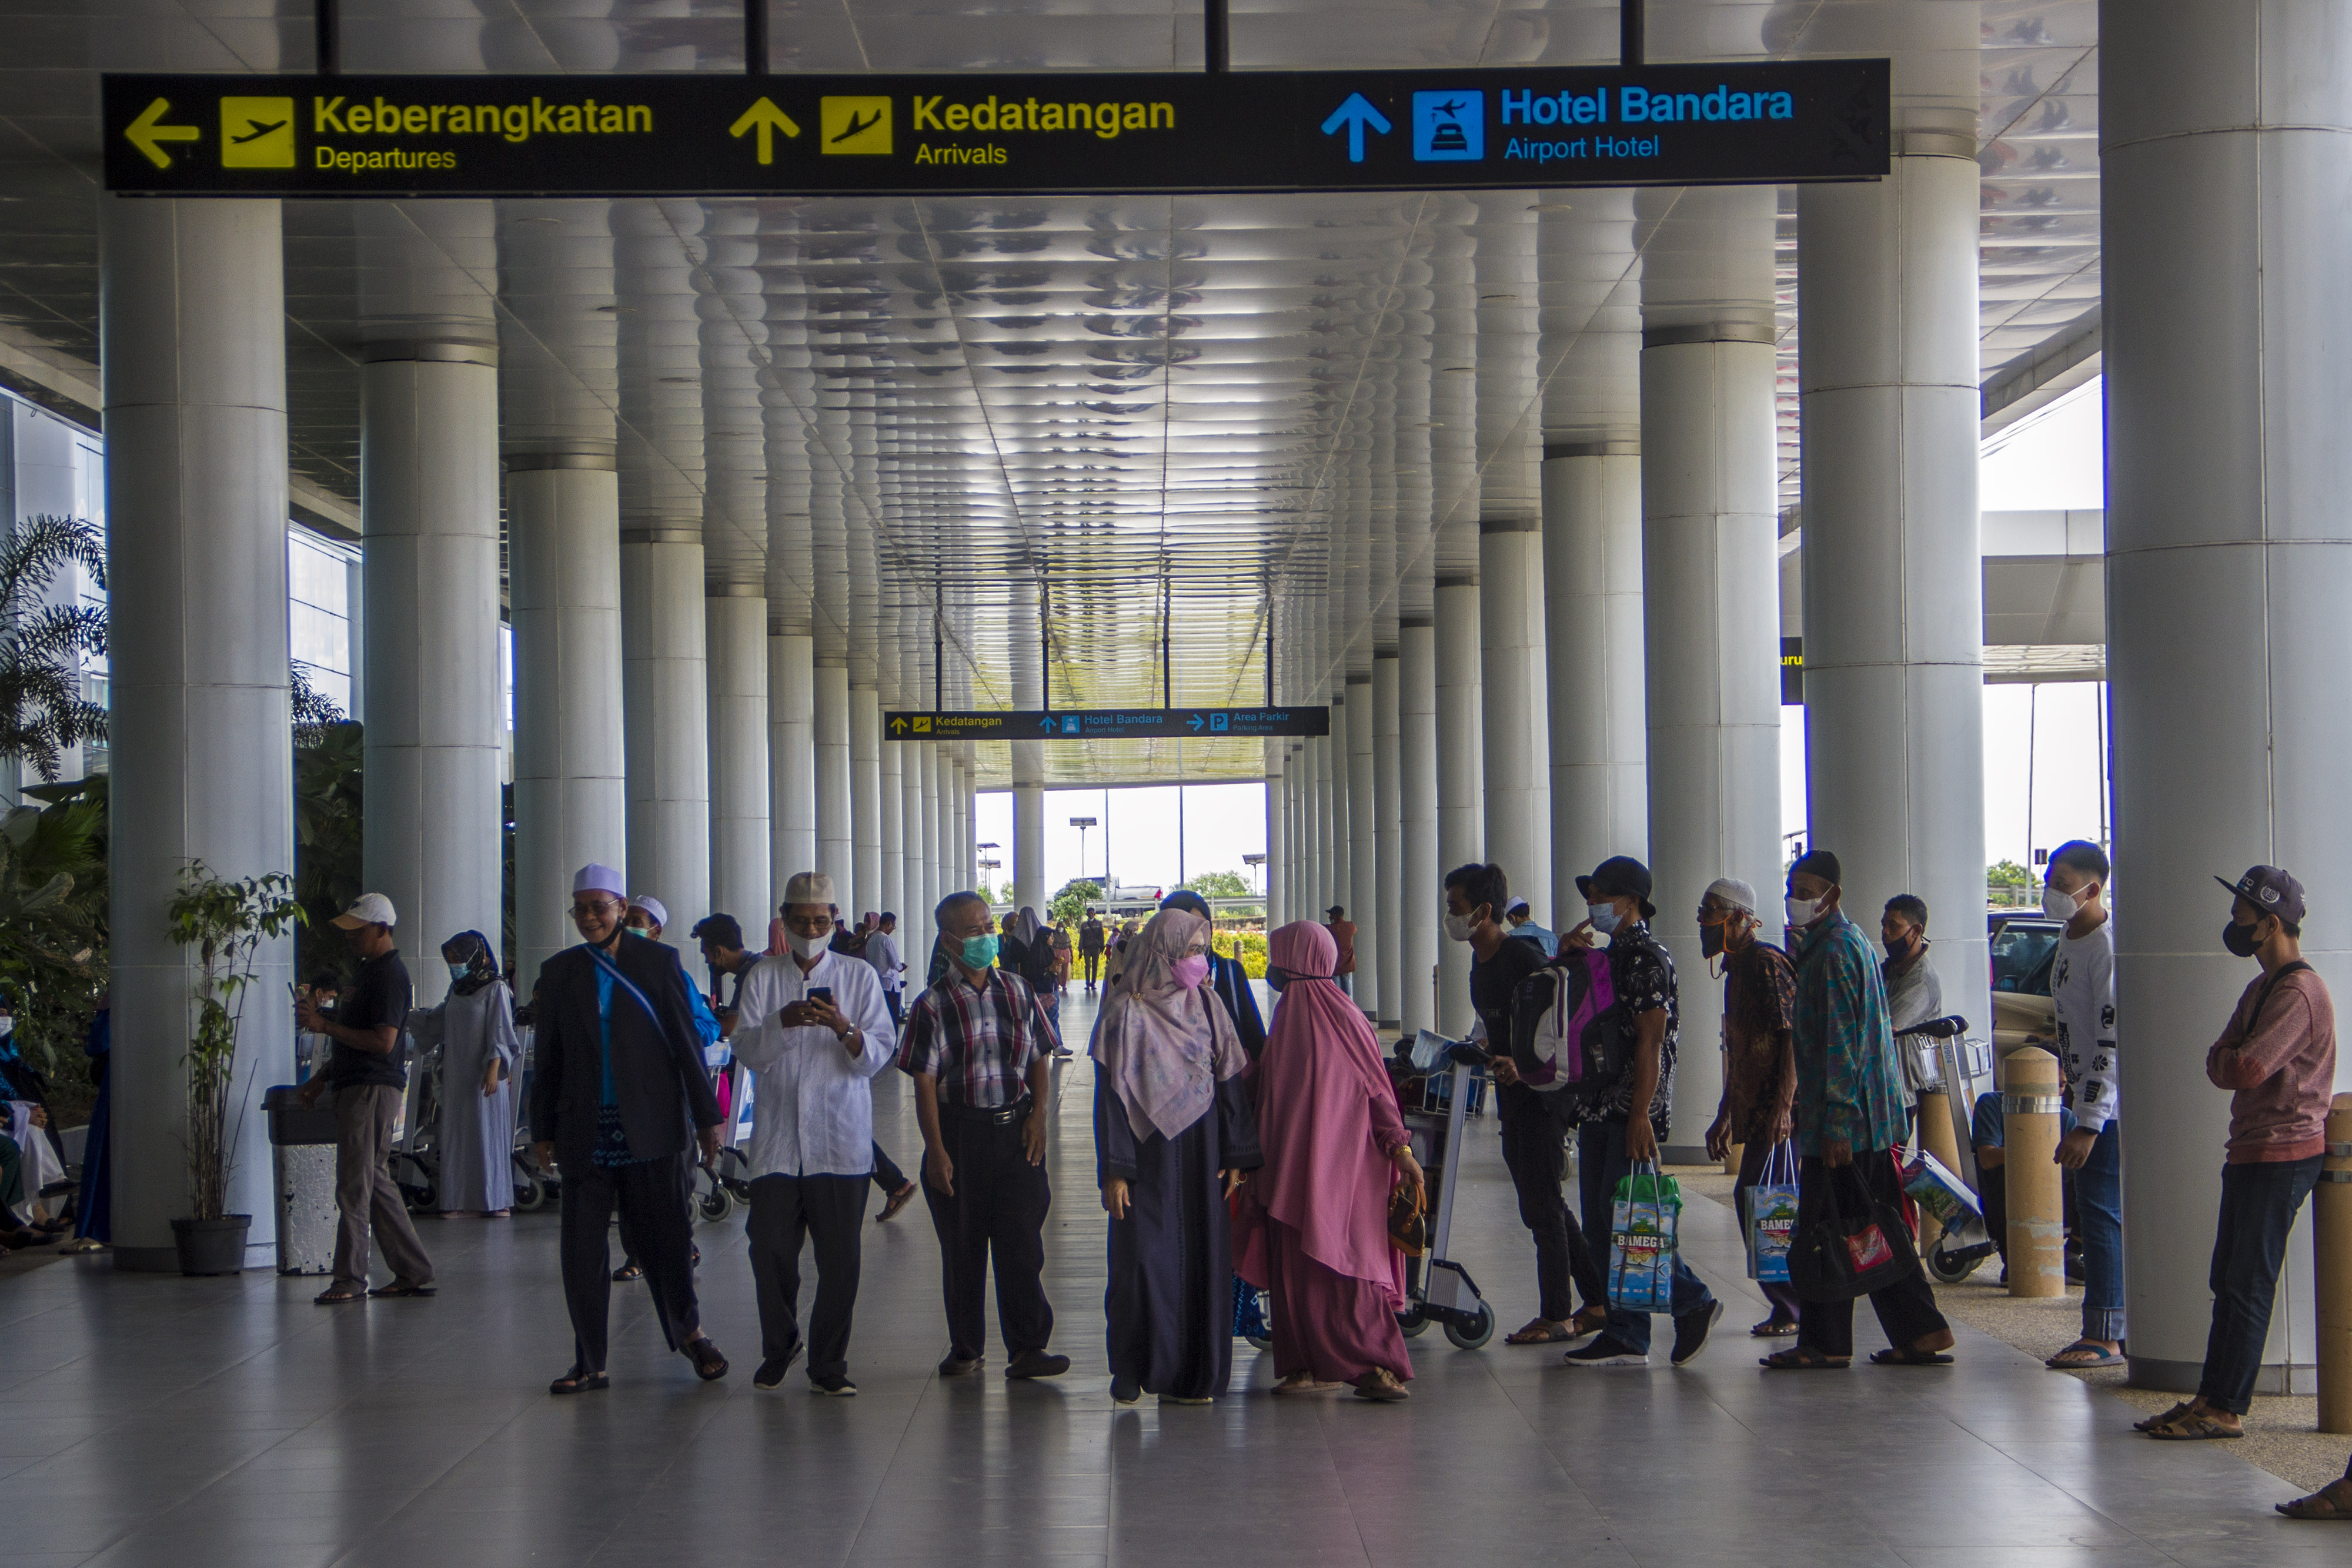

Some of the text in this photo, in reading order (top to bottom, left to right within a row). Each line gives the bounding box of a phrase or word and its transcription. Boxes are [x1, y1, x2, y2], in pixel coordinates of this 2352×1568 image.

[1500, 83, 1795, 125] Hotel Bandara
[313, 96, 653, 143] Keberangkatan
[913, 95, 1175, 139] Kedatangan
[914, 142, 1008, 165] Arrivals
[1504, 134, 1661, 164] Airport Hotel
[315, 146, 456, 174] Departures
[936, 716, 1002, 728] Kedatangan
[1084, 714, 1163, 724] Hotel Bandara
[1234, 712, 1289, 721] Area Parkir
[1232, 724, 1257, 733] Parking
[1943, 1045, 1953, 1064] 0904
[1760, 1219, 1794, 1231] BAME
[1617, 1235, 1665, 1248] BAMEGA
